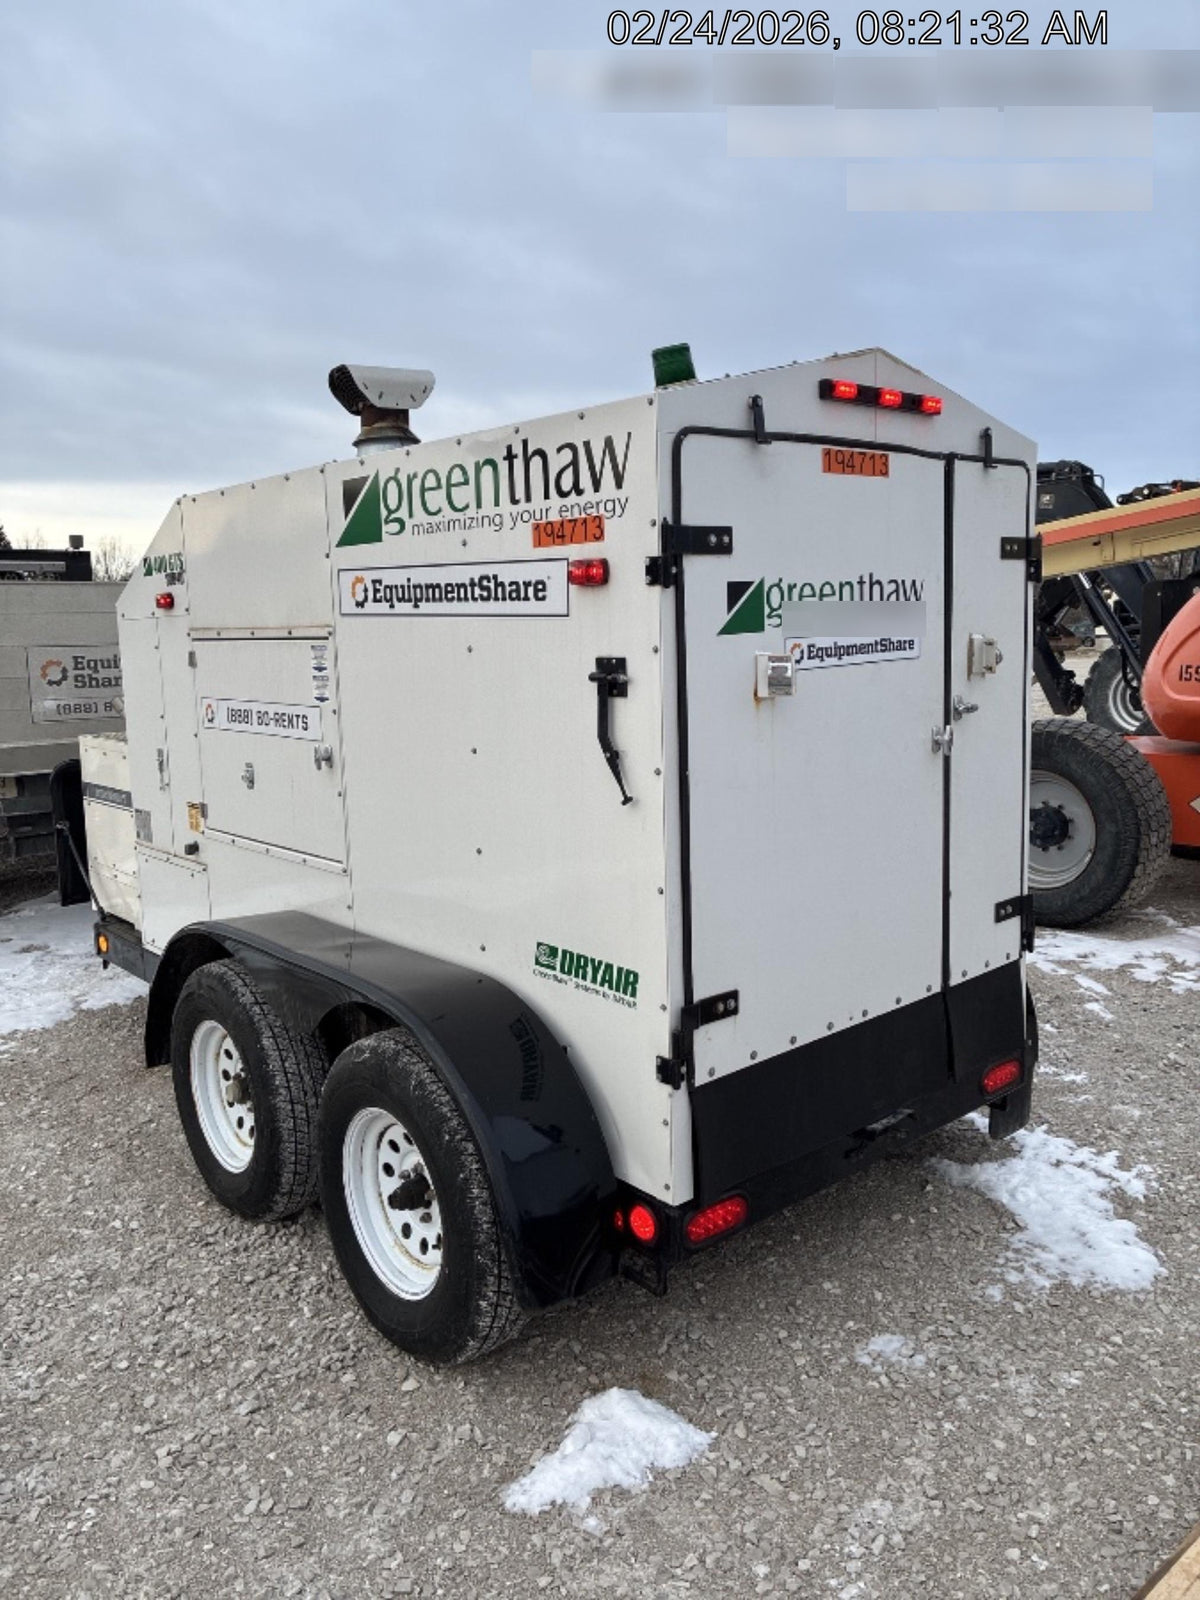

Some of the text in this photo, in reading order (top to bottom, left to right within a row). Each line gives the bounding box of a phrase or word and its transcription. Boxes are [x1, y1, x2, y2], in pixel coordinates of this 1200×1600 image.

[823, 449, 889, 477] 194713
[381, 431, 632, 536] greenthaw
[411, 495, 630, 535] maximizing your energy
[533, 514, 605, 547] 194713
[370, 573, 549, 609] EquipmentShare
[72, 654, 122, 674] Equi
[806, 637, 915, 664] EquipmentShare
[73, 673, 123, 689] Shar
[560, 948, 639, 999] DRYAIR
